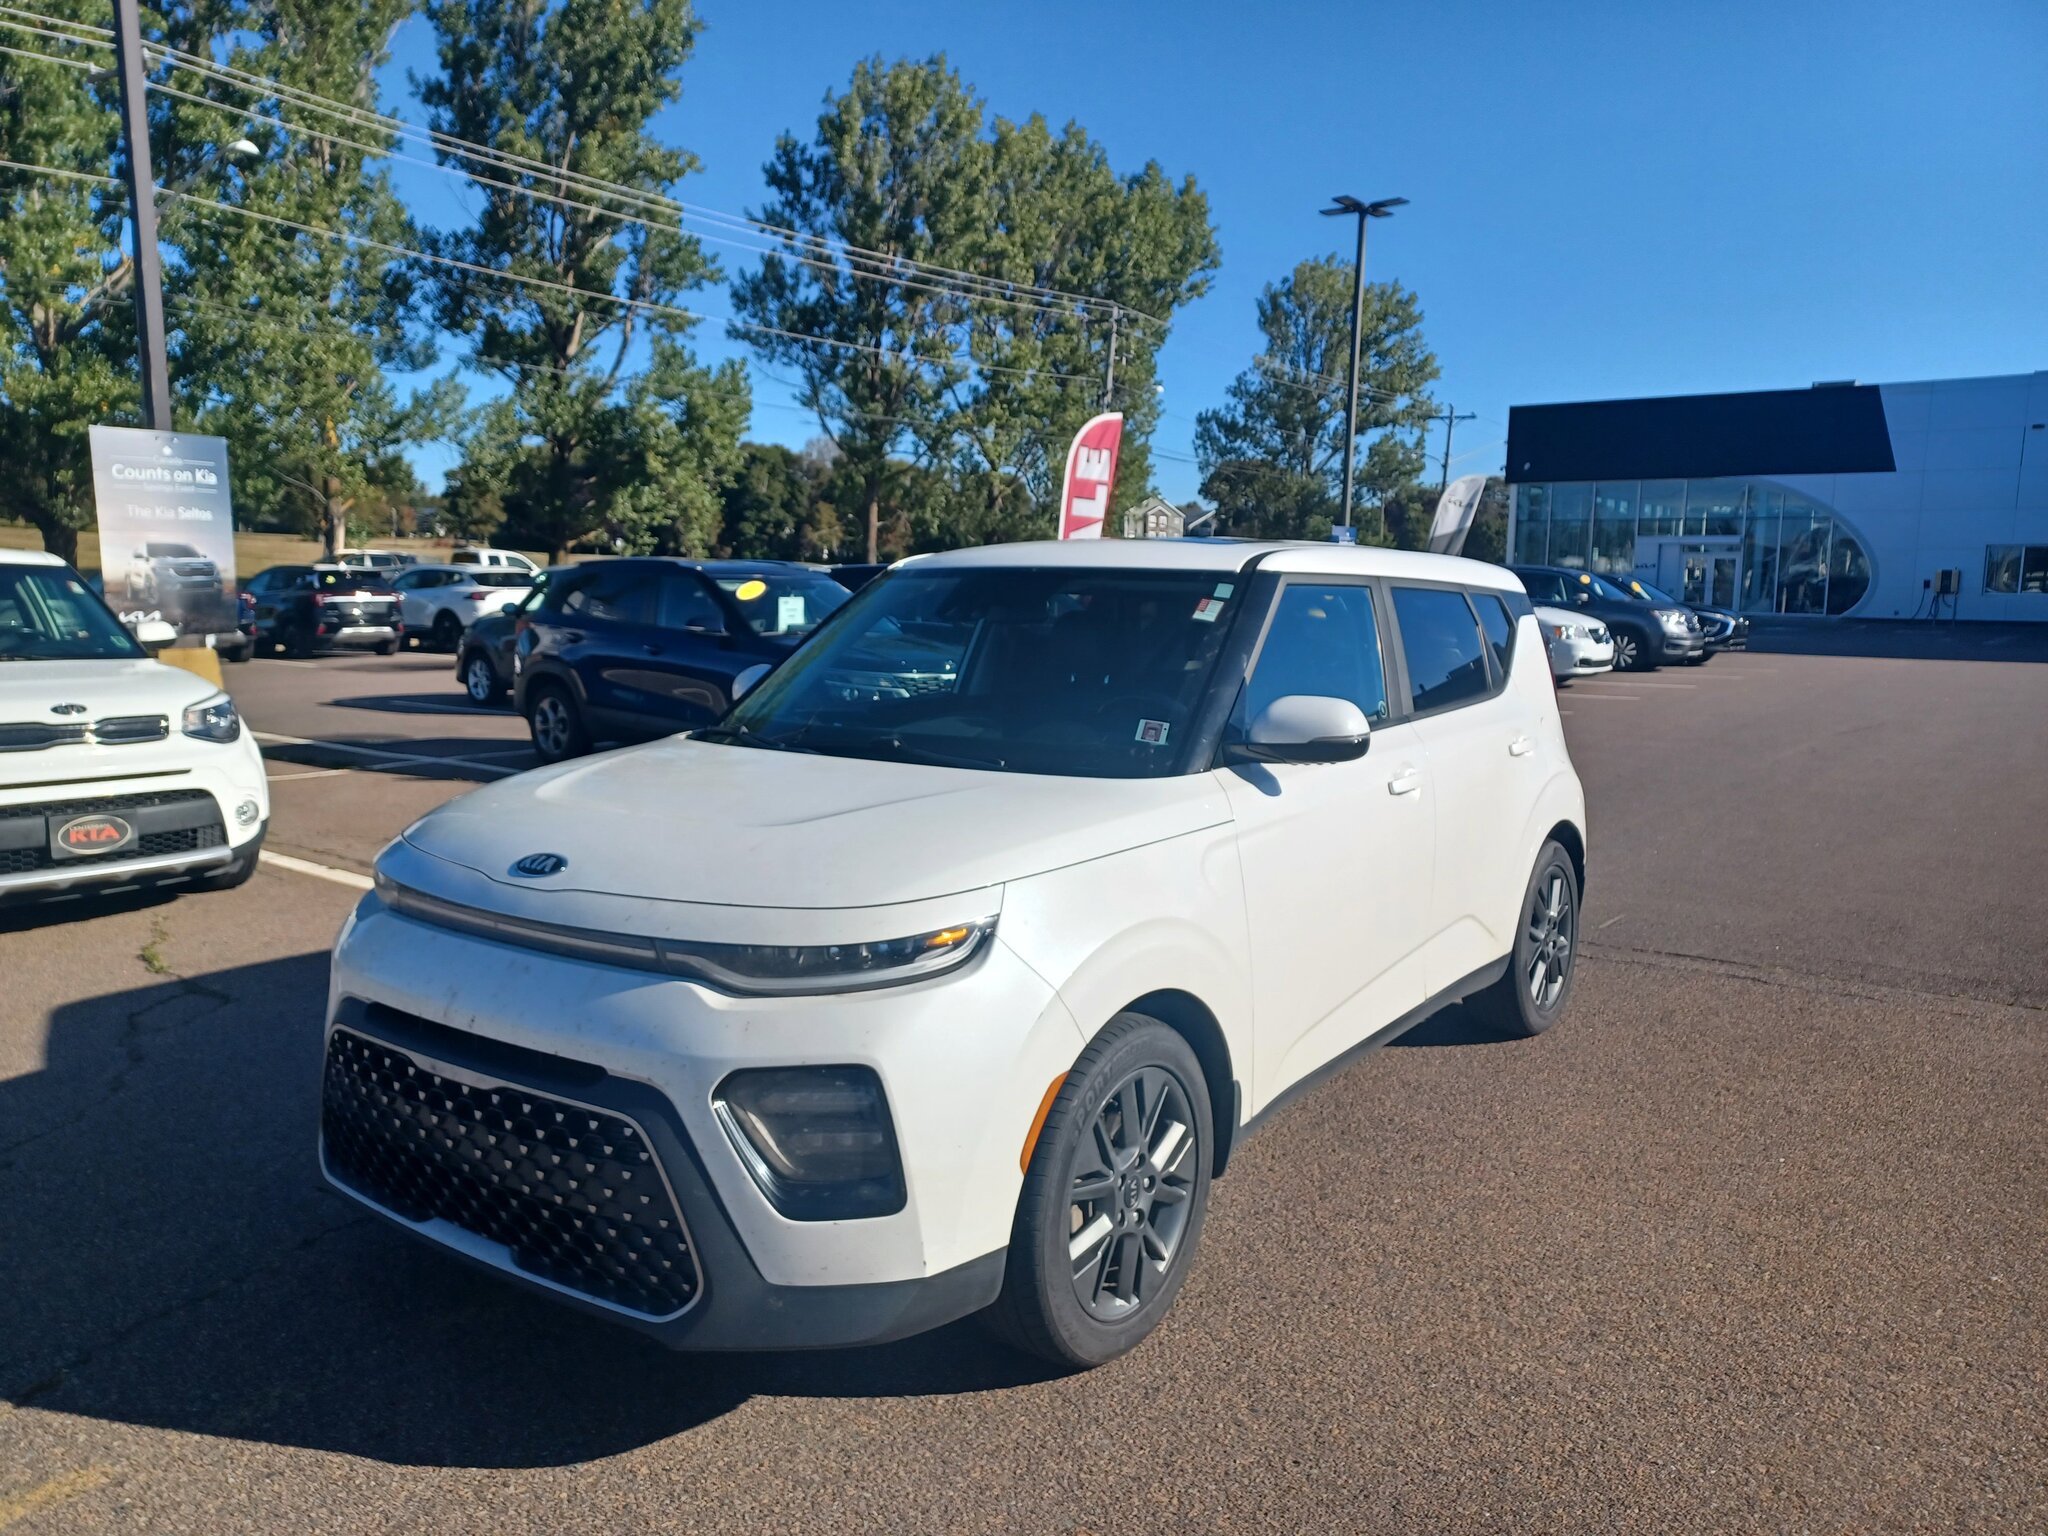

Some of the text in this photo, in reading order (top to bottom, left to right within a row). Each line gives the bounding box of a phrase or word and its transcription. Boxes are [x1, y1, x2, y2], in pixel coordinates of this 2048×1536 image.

[112, 463, 218, 485] Counts on Kia
[127, 504, 152, 518] The
[155, 505, 175, 519] Kia
[518, 854, 559, 873] KIA
